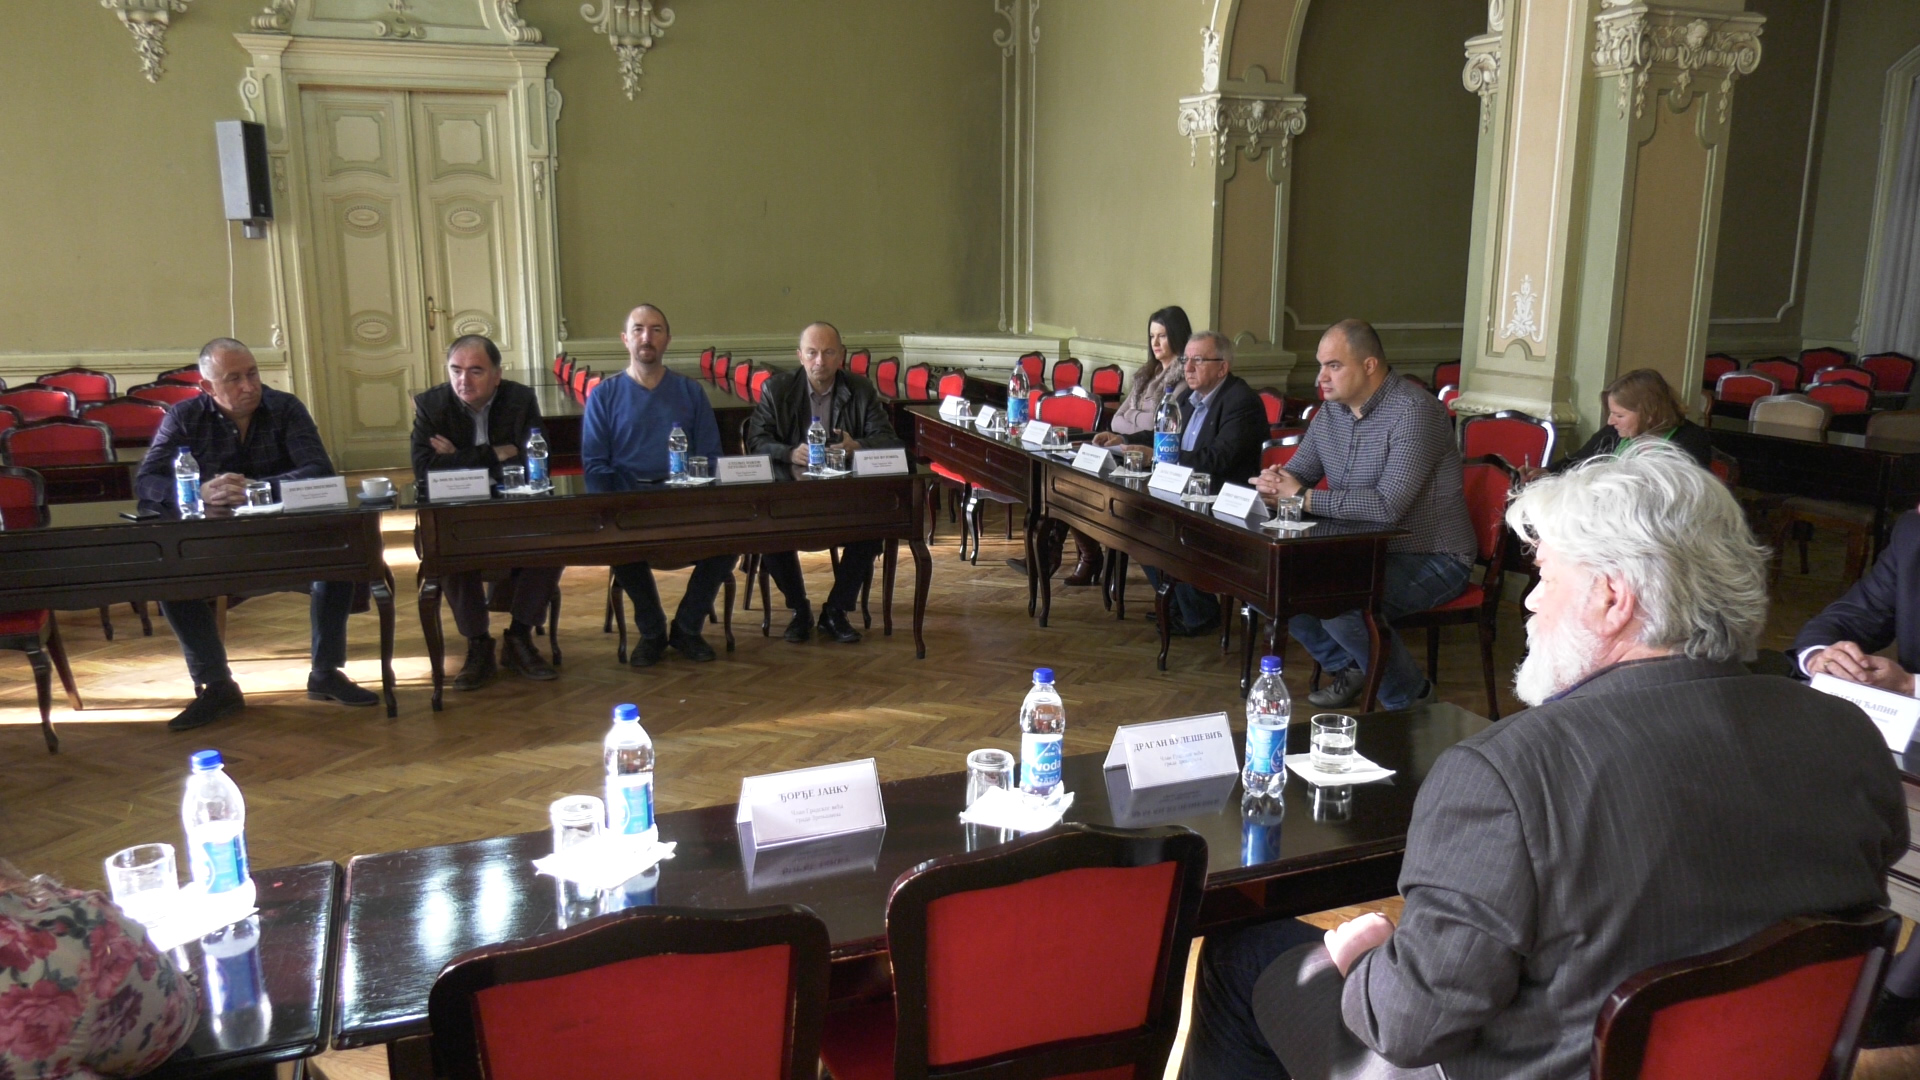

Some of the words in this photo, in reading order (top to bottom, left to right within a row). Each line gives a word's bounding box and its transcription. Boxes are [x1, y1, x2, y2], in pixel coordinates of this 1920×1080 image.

[1134, 739, 1168, 752] ДРАГАН
[1035, 759, 1061, 772] voda
[778, 789, 815, 803] ЂОРЂЕ
[817, 784, 850, 797] ЈАНКУ
